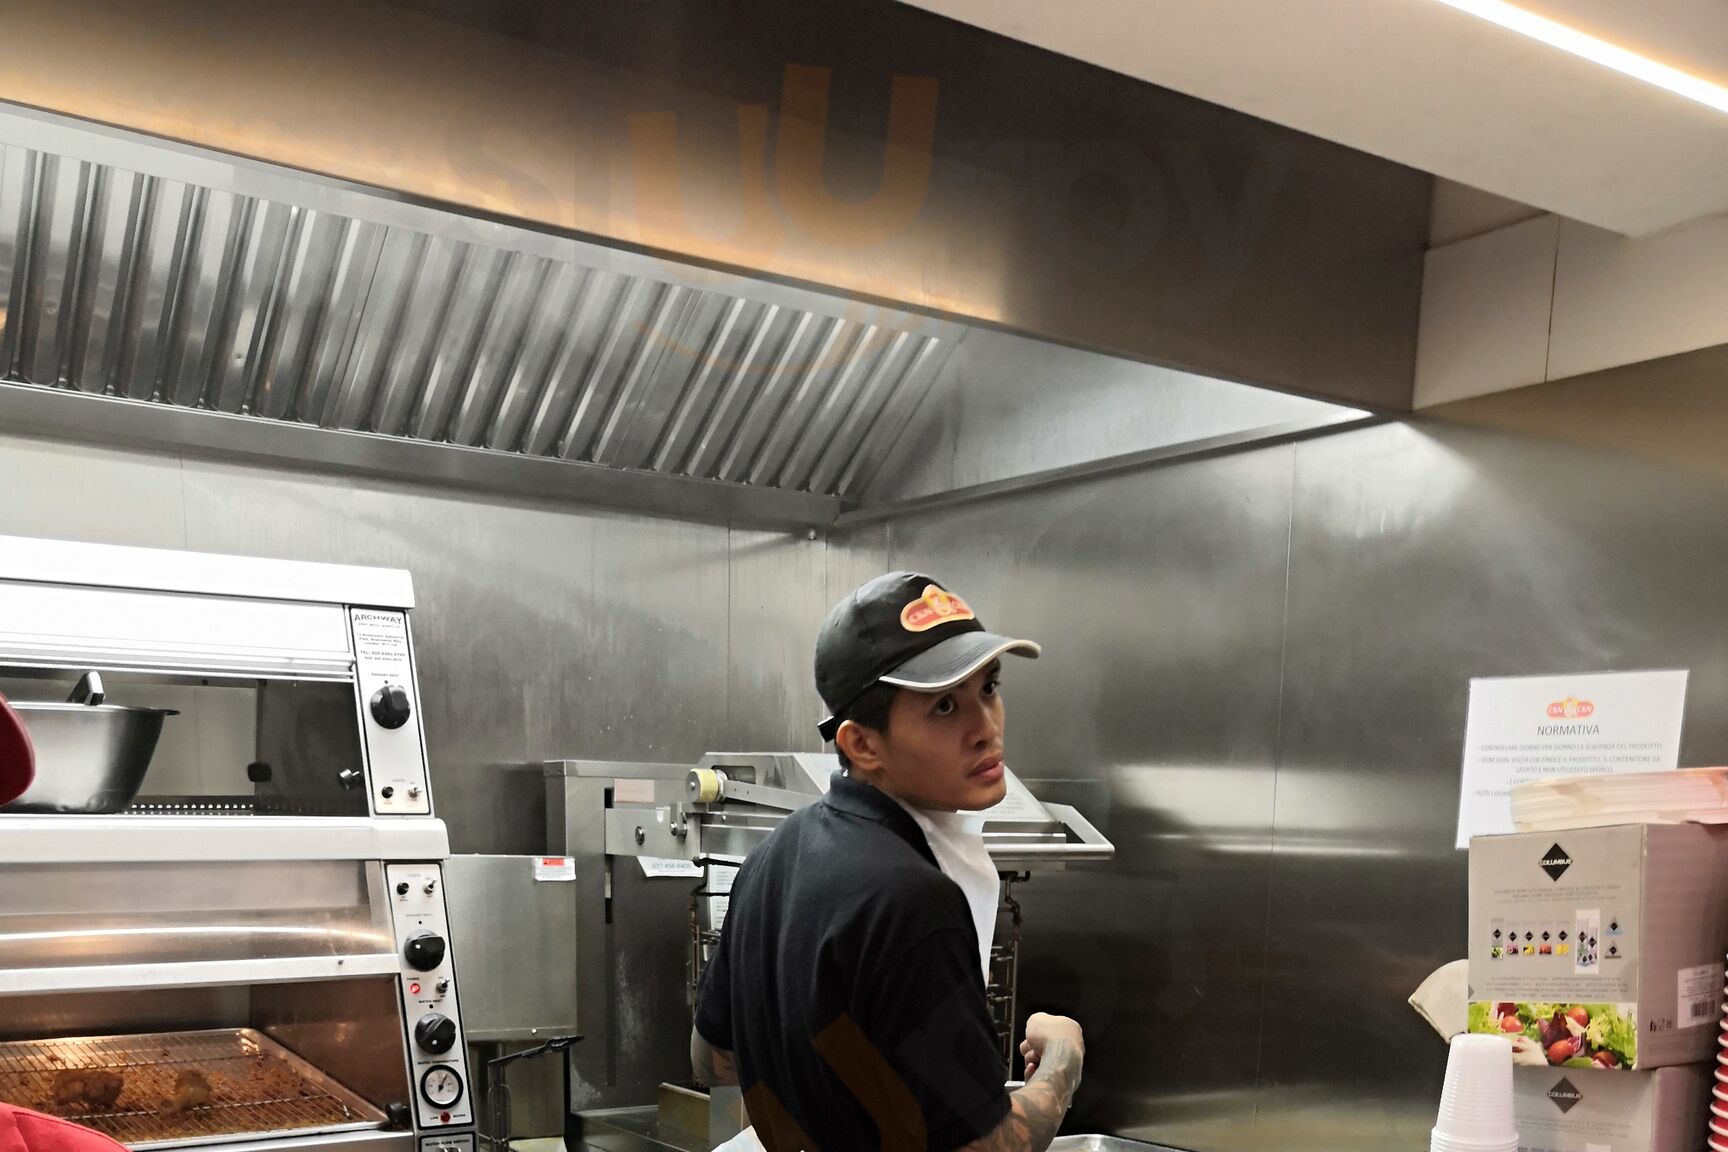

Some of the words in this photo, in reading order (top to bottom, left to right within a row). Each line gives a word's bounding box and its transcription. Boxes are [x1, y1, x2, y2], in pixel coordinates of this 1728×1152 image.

[354, 614, 402, 624] ARCHWAY
[1537, 724, 1600, 736] NORMATIVA
[1539, 858, 1572, 866] COLUMBUS
